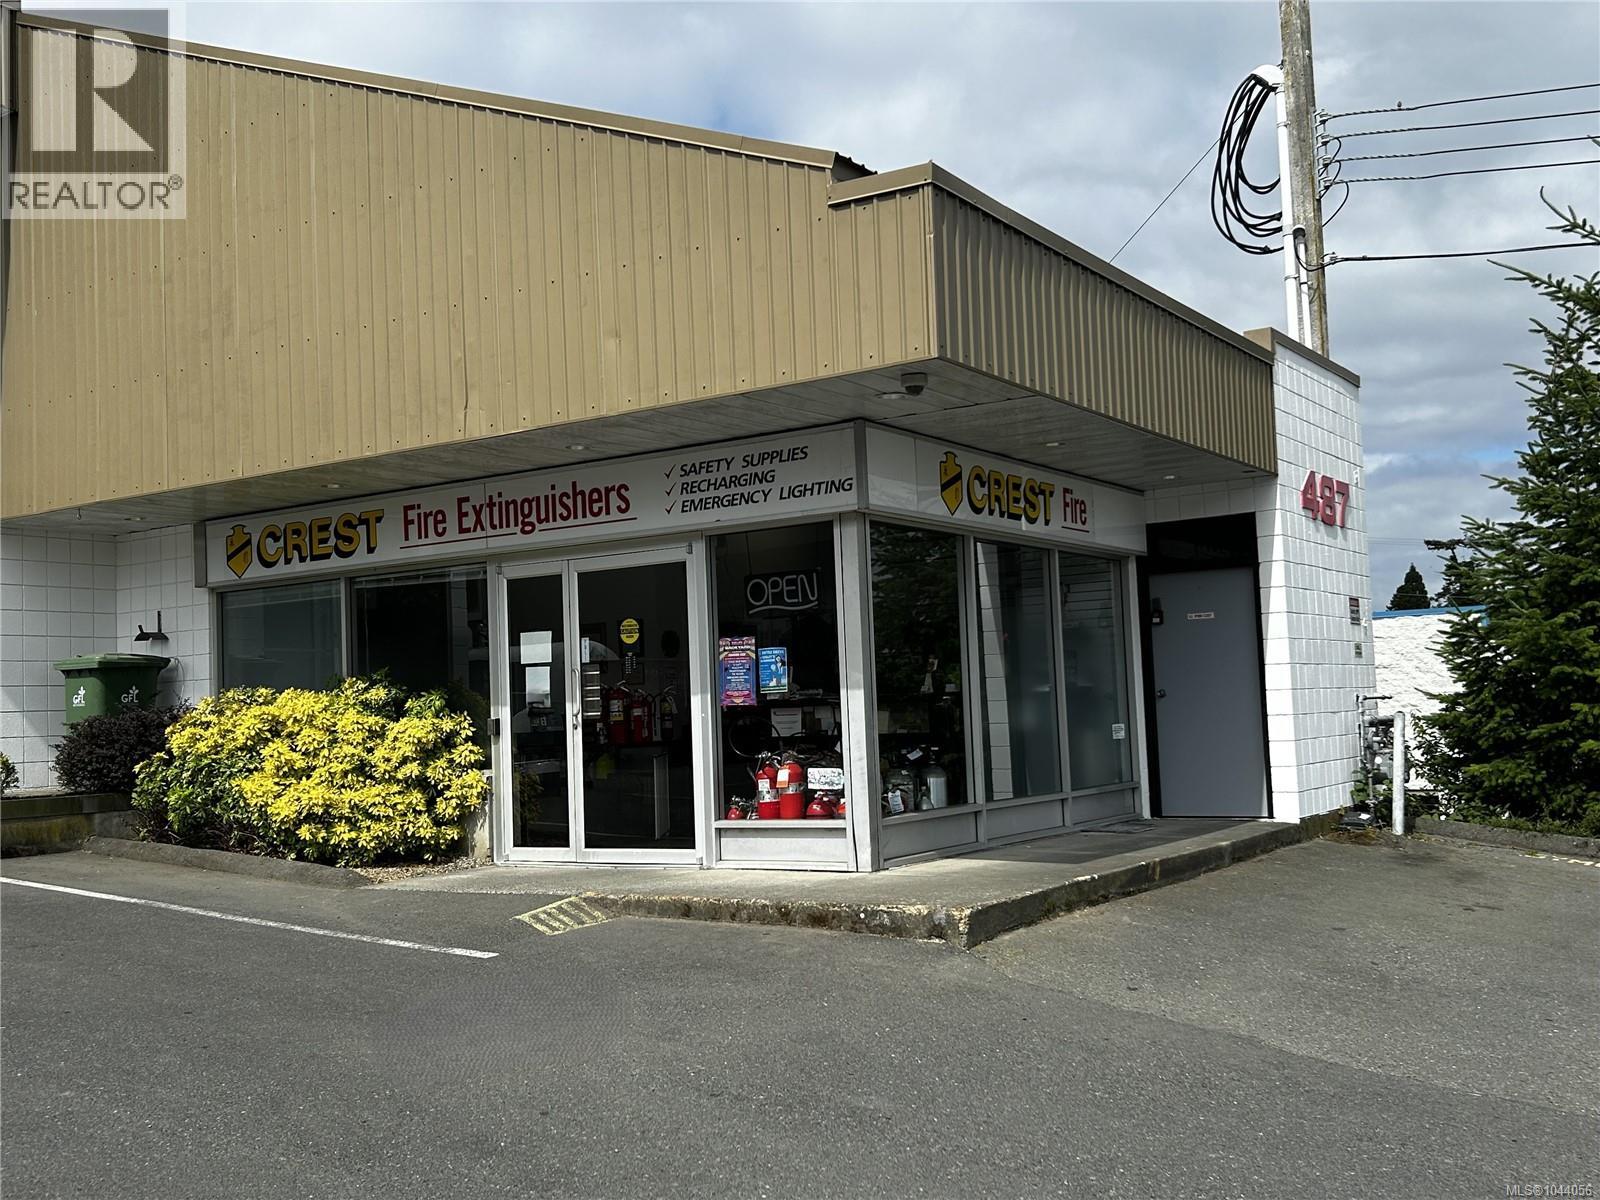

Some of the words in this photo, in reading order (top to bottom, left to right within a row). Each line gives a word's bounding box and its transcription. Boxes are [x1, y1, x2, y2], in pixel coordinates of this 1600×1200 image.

[680, 457, 734, 477] SAFETY
[741, 446, 809, 468] SUPPLIES
[680, 469, 775, 495] RECHARGING
[680, 488, 772, 513] EMERGENCY
[779, 477, 853, 500] LIGHTING
[967, 465, 1055, 526] CREST
[1062, 487, 1088, 525] Fire
[1299, 469, 1350, 528] 487
[257, 509, 384, 568] CREST
[403, 503, 446, 541] Fire
[457, 481, 631, 535] Extinguishers
[747, 572, 818, 606] OPEN
